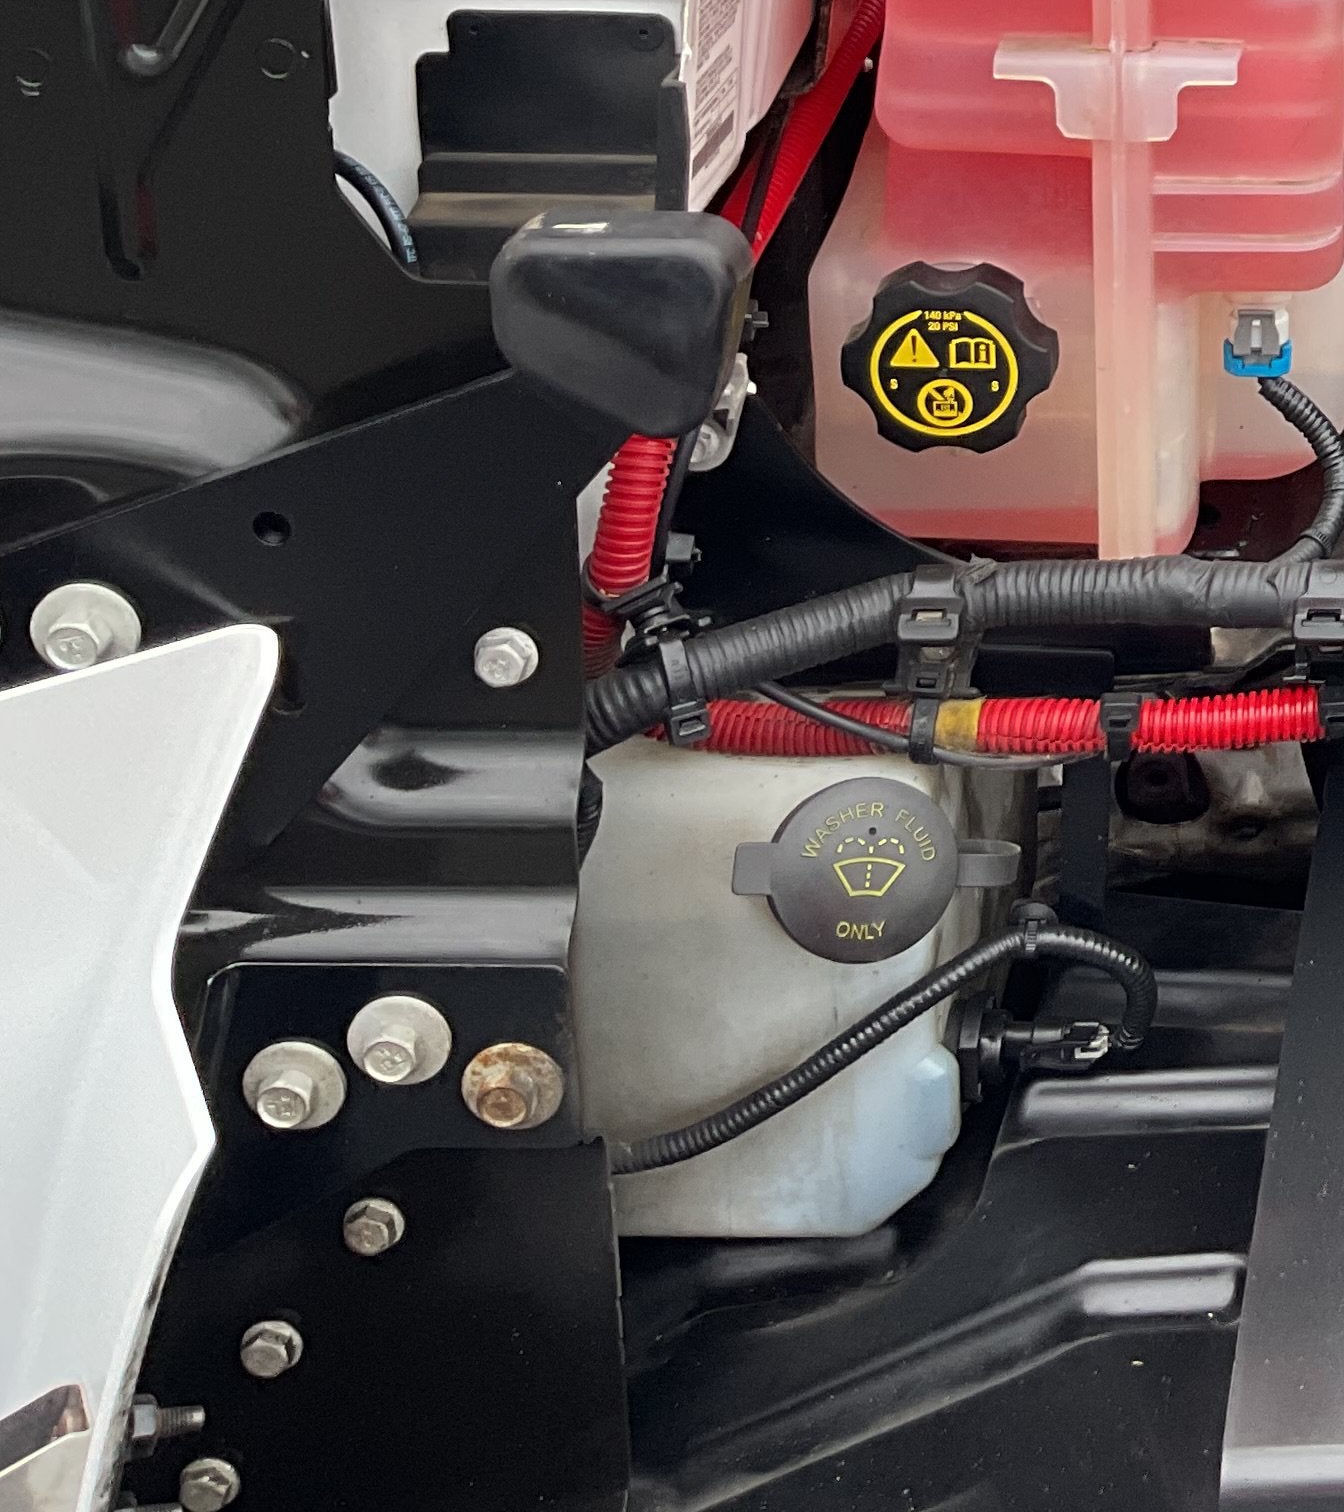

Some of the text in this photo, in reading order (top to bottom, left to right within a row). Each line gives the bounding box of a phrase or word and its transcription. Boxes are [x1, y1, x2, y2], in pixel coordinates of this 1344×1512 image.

[923, 310, 962, 321] 140 kPa
[927, 321, 959, 332] 20 PSI
[801, 802, 936, 861] WASHER FLUID
[836, 920, 887, 940] ONLY
